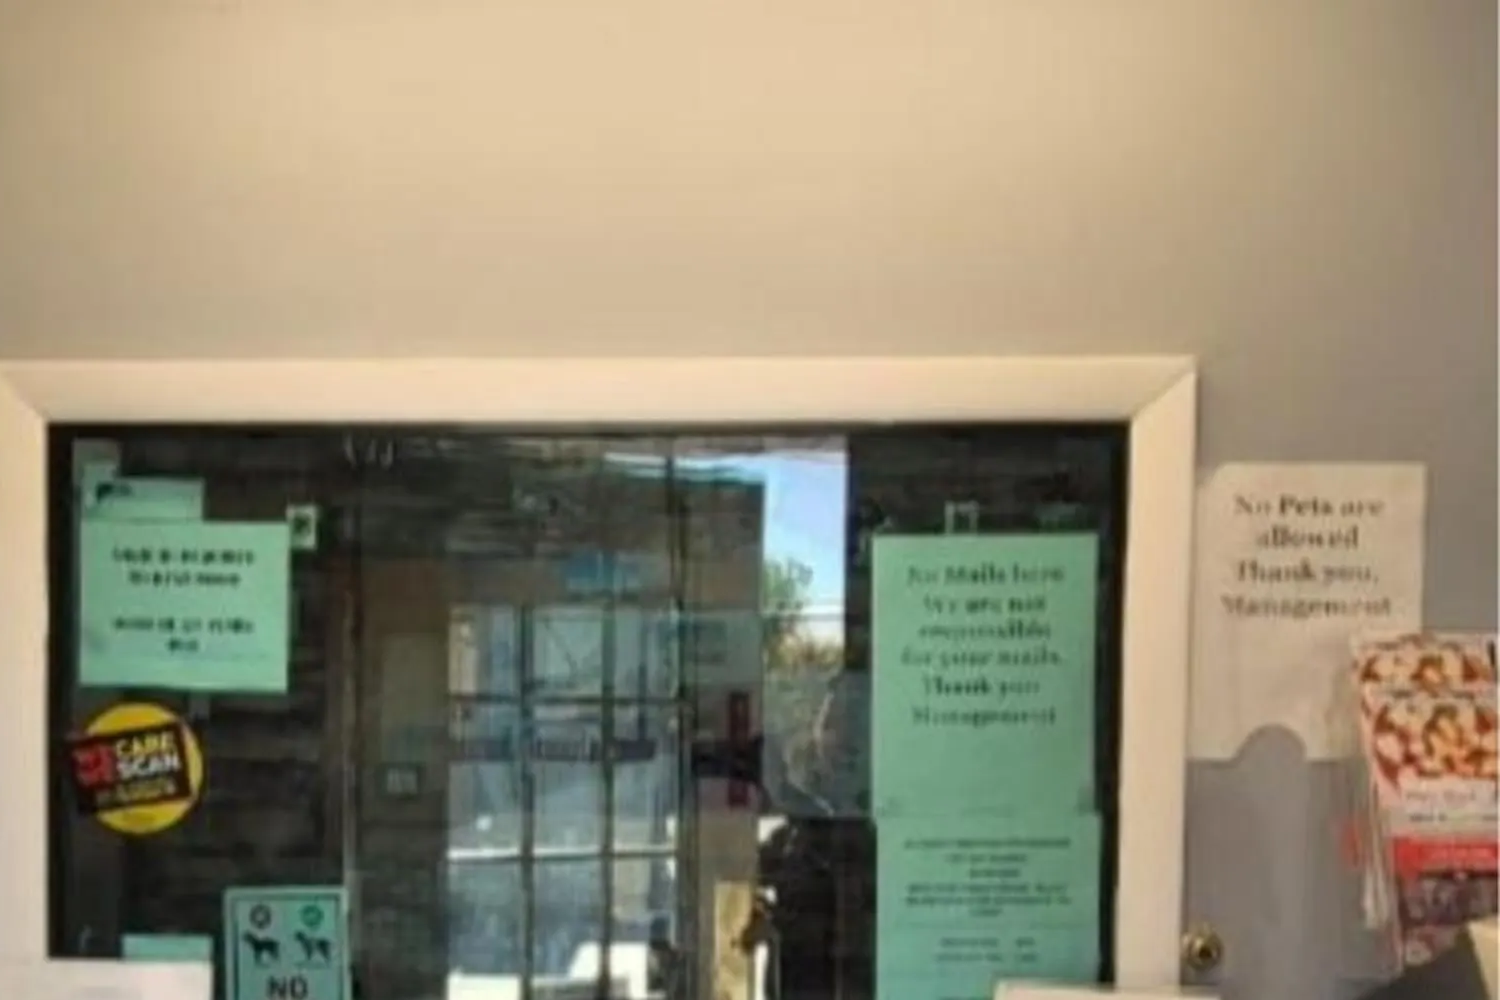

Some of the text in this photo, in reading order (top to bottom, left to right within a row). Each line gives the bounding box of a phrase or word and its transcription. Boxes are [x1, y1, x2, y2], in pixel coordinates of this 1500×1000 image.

[1234, 493, 1386, 518] No Pets are
[1255, 523, 1359, 550] allowed
[944, 561, 1007, 585] Mails
[1236, 556, 1318, 582] Thank
[1218, 593, 1392, 620] Management
[917, 617, 1053, 641] responsible
[921, 675, 991, 696] Thank
[911, 705, 1057, 729] Management
[266, 974, 310, 1000] NO
